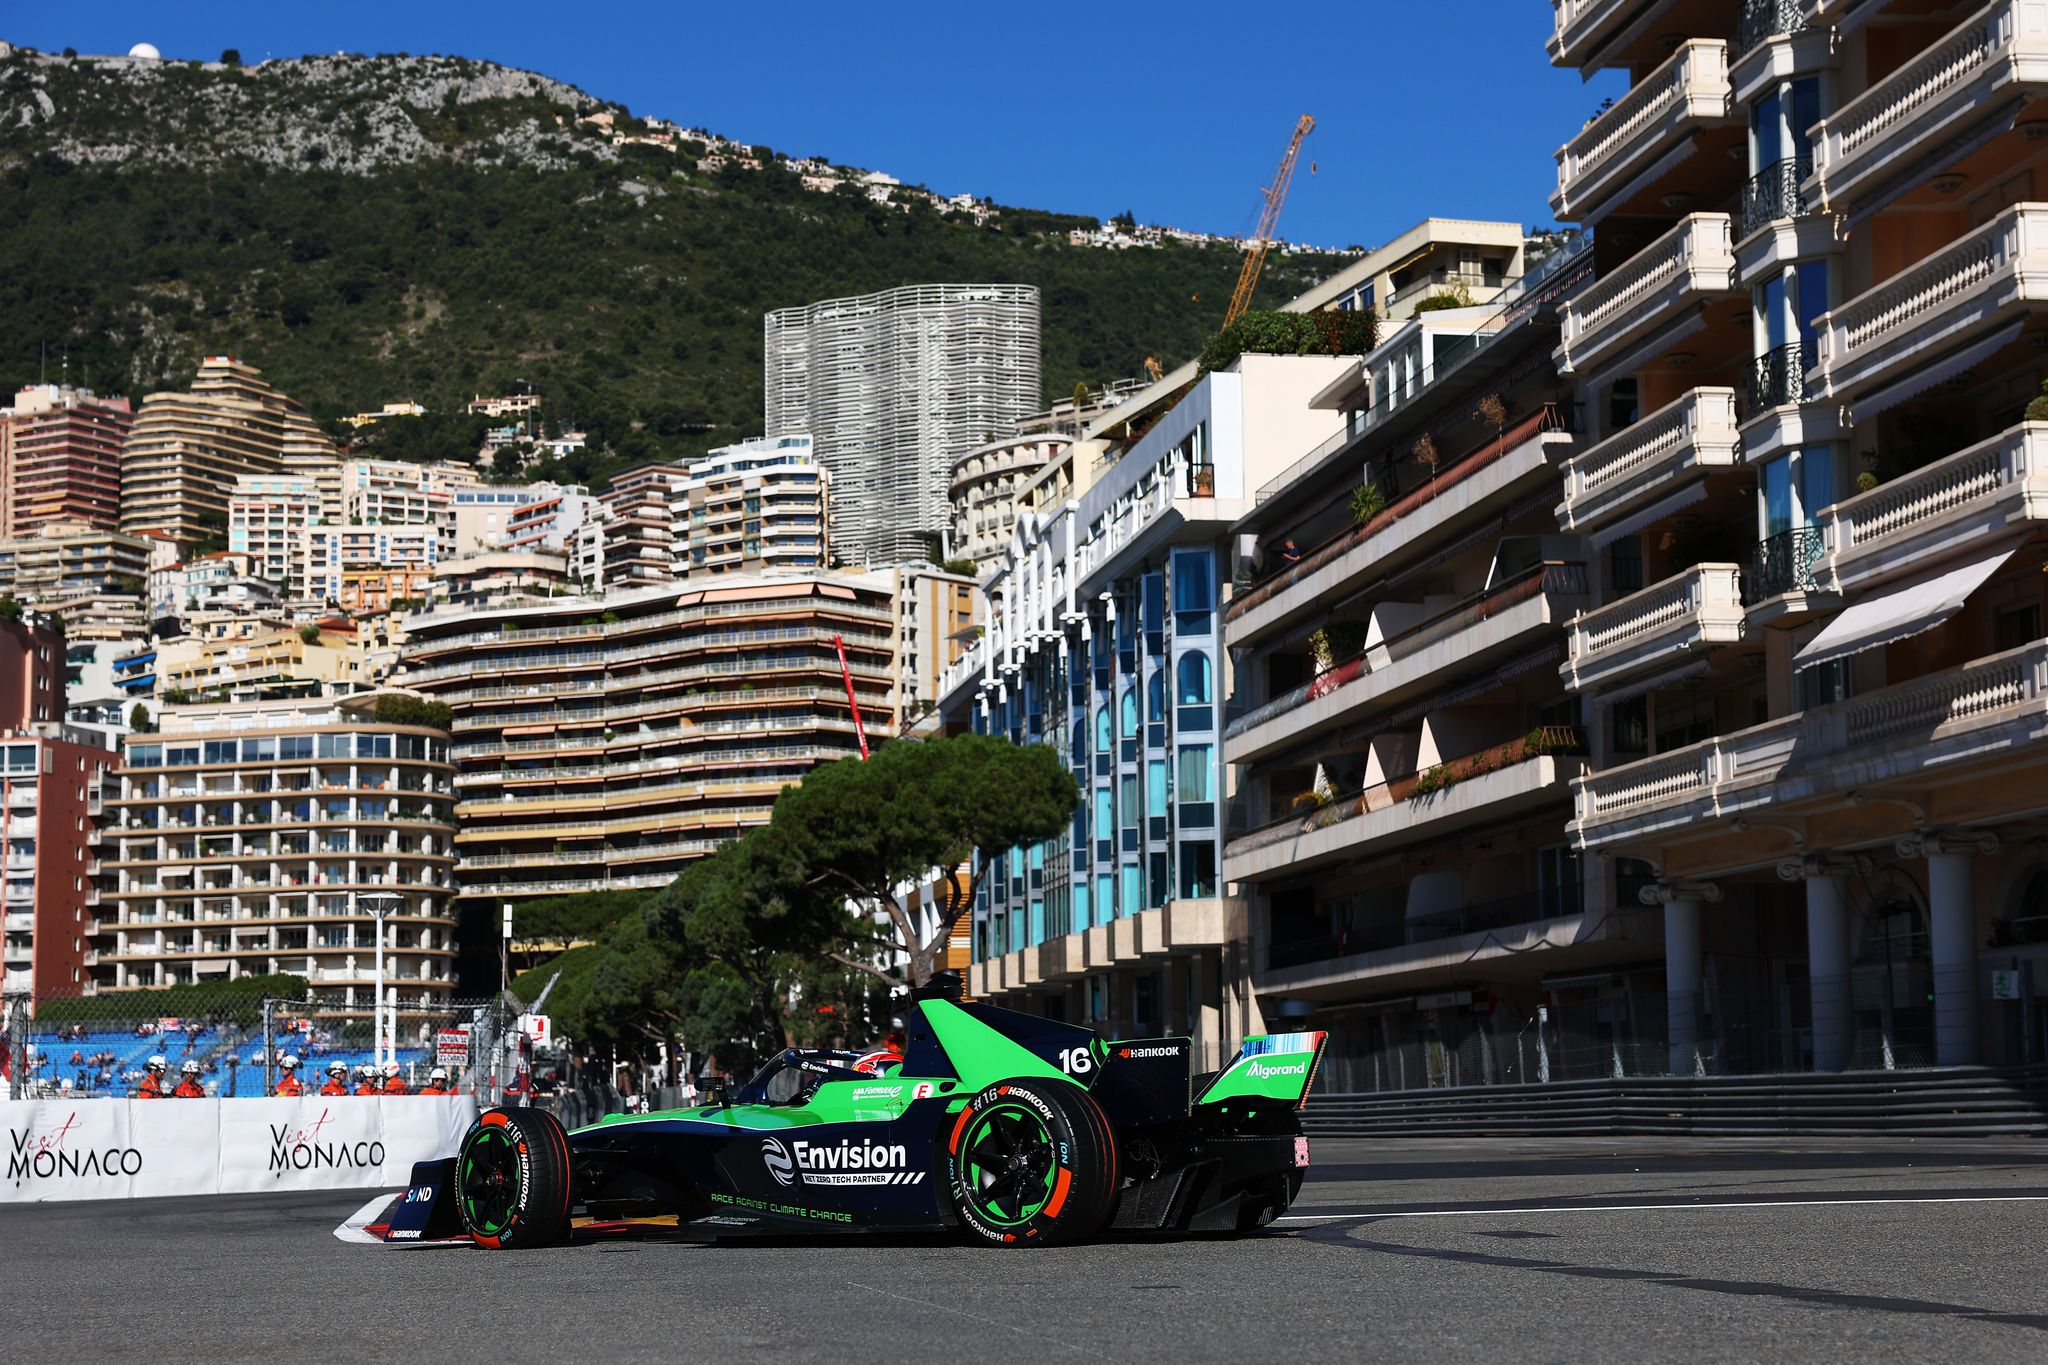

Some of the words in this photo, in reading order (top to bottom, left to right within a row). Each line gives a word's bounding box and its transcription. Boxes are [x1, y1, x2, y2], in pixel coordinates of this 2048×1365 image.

[809, 1064, 829, 1074] Envision
[1058, 1047, 1092, 1074] 16
[1245, 1060, 1305, 1079] Algorand
[917, 1085, 929, 1099] E
[10, 1111, 82, 1160] Visit
[270, 1107, 335, 1153] Visit
[7, 1148, 142, 1180] MONACO
[269, 1141, 385, 1171] MONACO
[793, 1138, 906, 1169] Envision
[832, 1176, 851, 1184] TECH
[852, 1175, 886, 1184] PARTNER
[711, 1193, 734, 1205] RACE
[736, 1197, 767, 1210] AGAINST
[770, 1203, 807, 1217] CLIMATE
[809, 1209, 852, 1223] CHANGE
